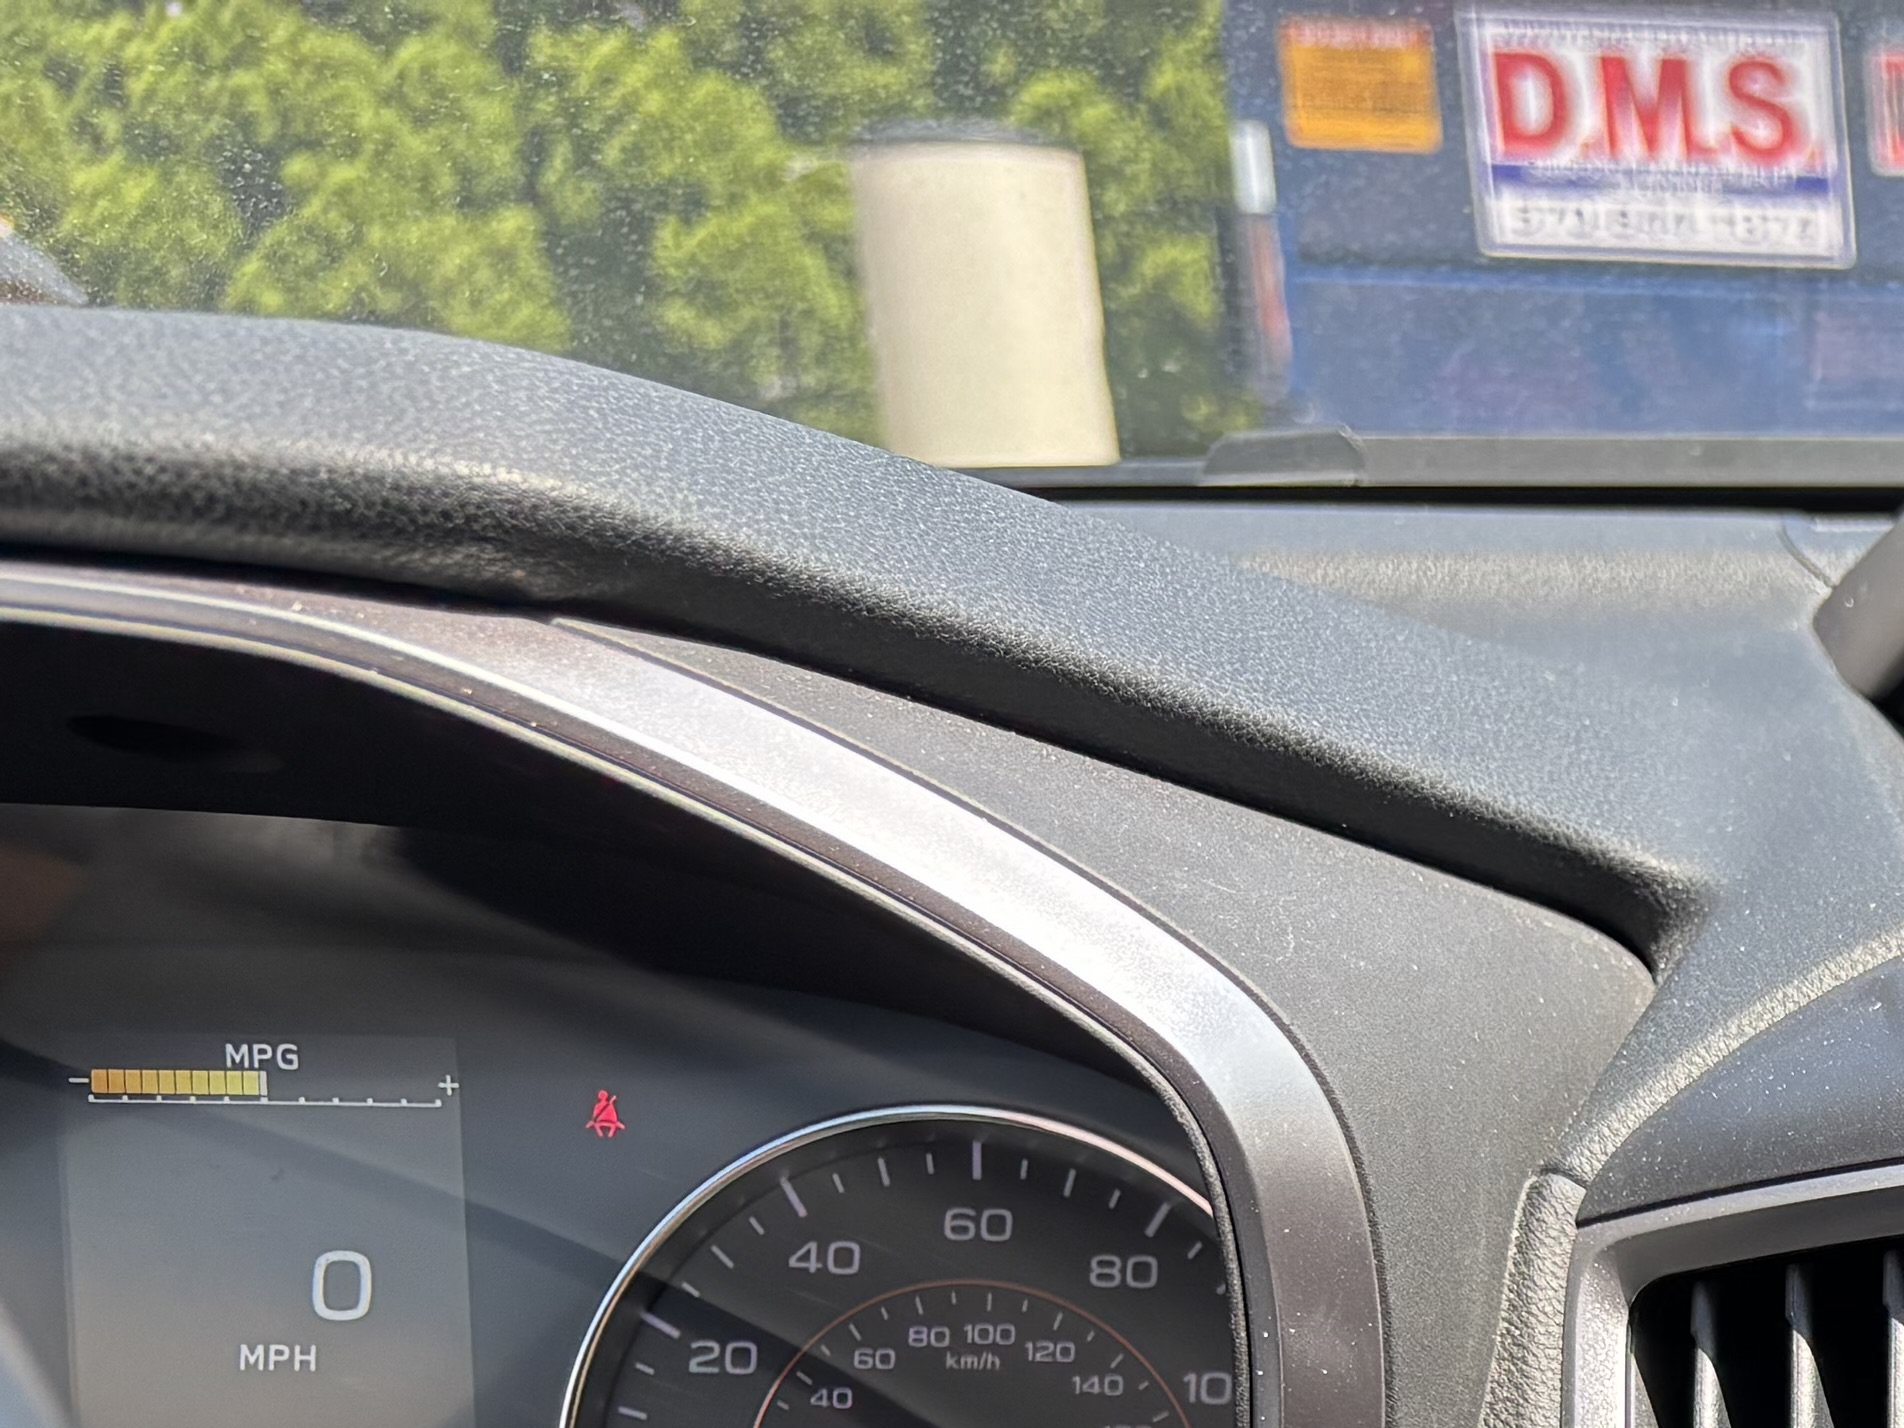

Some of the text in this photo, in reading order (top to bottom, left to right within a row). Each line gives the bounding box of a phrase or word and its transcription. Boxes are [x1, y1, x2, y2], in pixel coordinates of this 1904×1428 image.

[224, 1042, 299, 1071] MPG
[944, 1208, 1012, 1241] 60
[789, 1241, 860, 1274] 40
[1089, 1255, 1157, 1288] 80
[312, 1251, 371, 1320] 0
[908, 1326, 950, 1347] 80
[964, 1323, 1015, 1345] 100
[240, 1344, 316, 1371] MPH
[689, 1340, 757, 1374] 20
[853, 1348, 895, 1369] 60
[946, 1351, 1000, 1370] km/h
[1025, 1341, 1075, 1362] 120
[810, 1388, 852, 1409] 40
[1072, 1374, 1123, 1396] 140
[1182, 1373, 1233, 1404] 10
